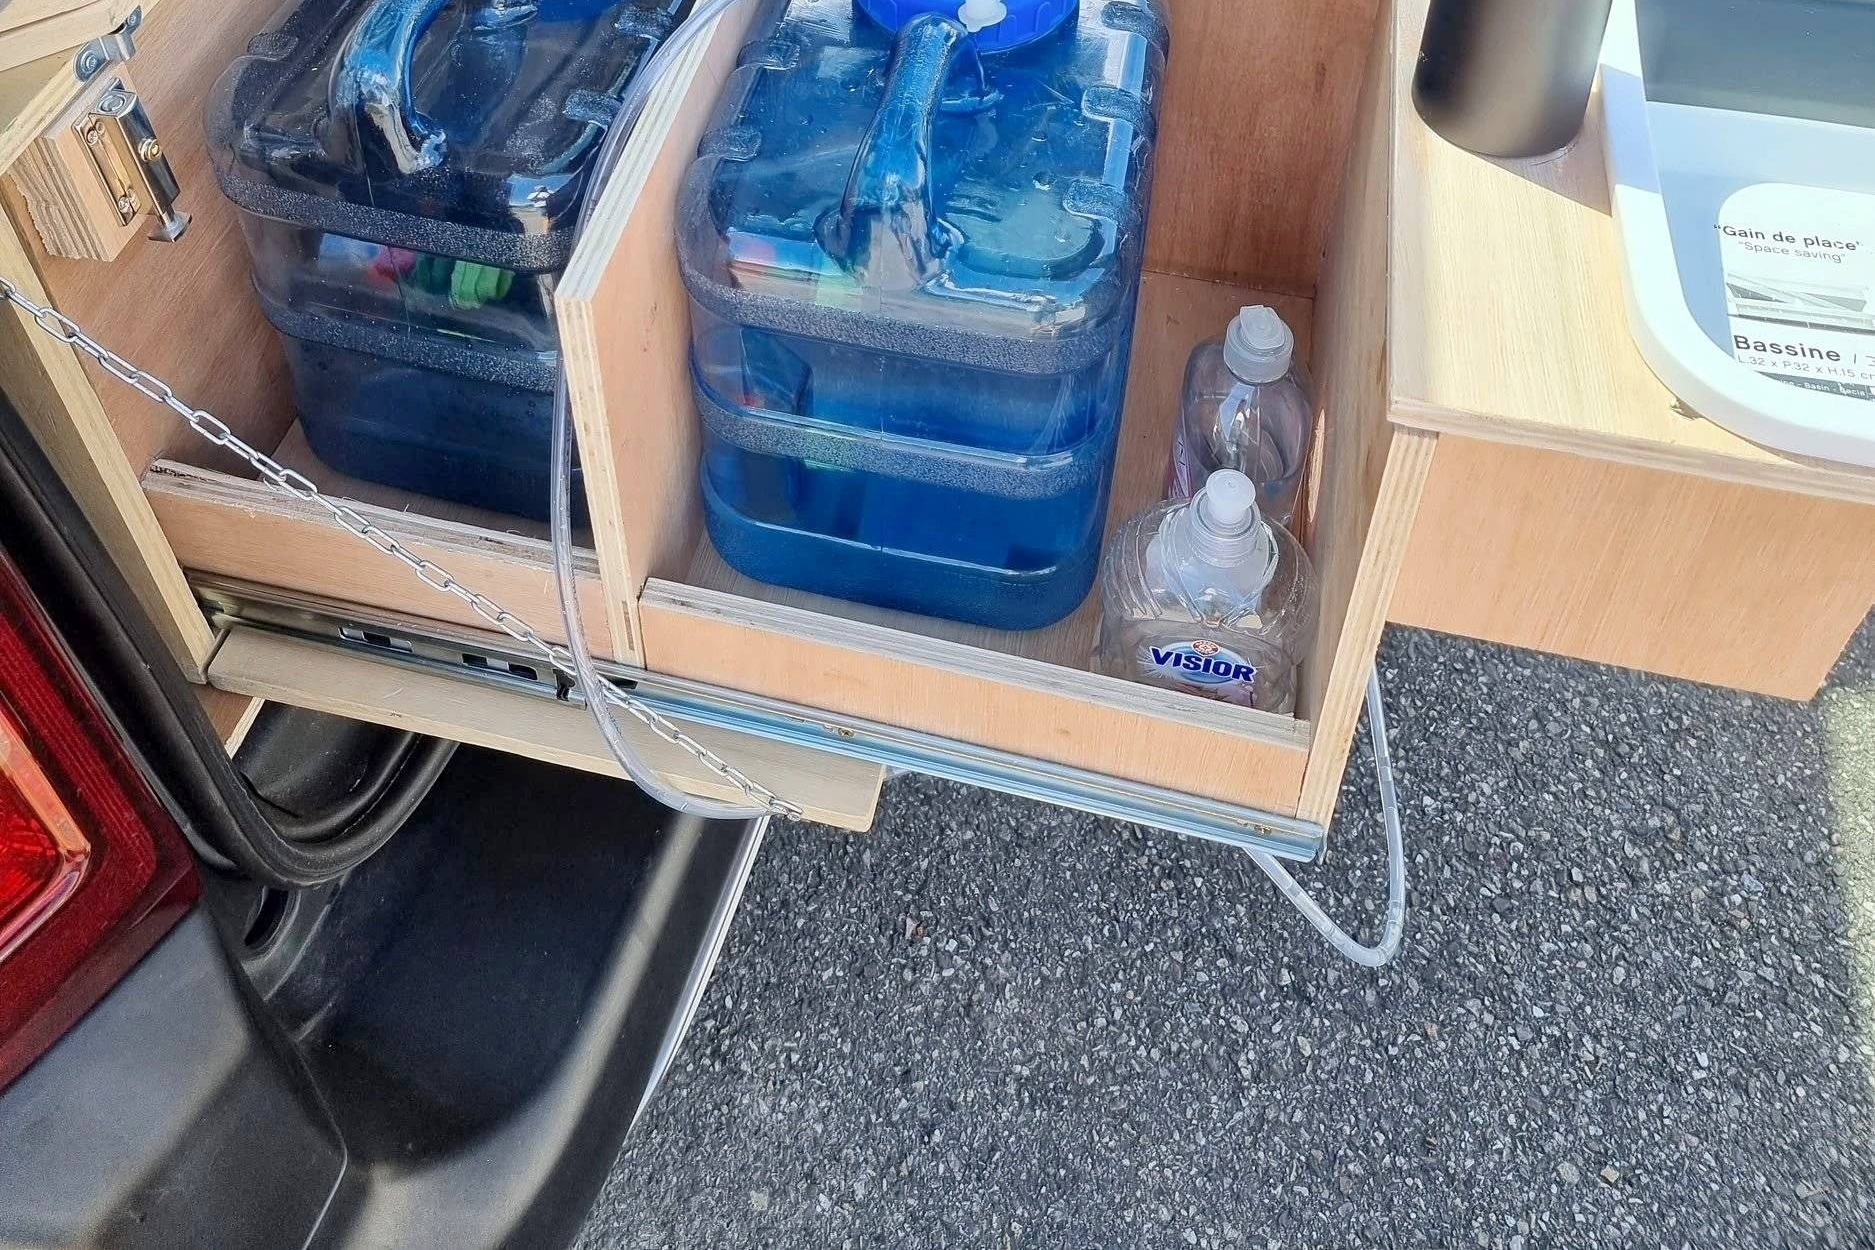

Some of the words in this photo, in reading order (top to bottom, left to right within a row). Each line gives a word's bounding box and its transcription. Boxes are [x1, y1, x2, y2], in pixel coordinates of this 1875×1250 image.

[1772, 231, 1796, 244] de
[1734, 334, 1841, 362] Bassine
[1150, 646, 1256, 682] VISIOR
